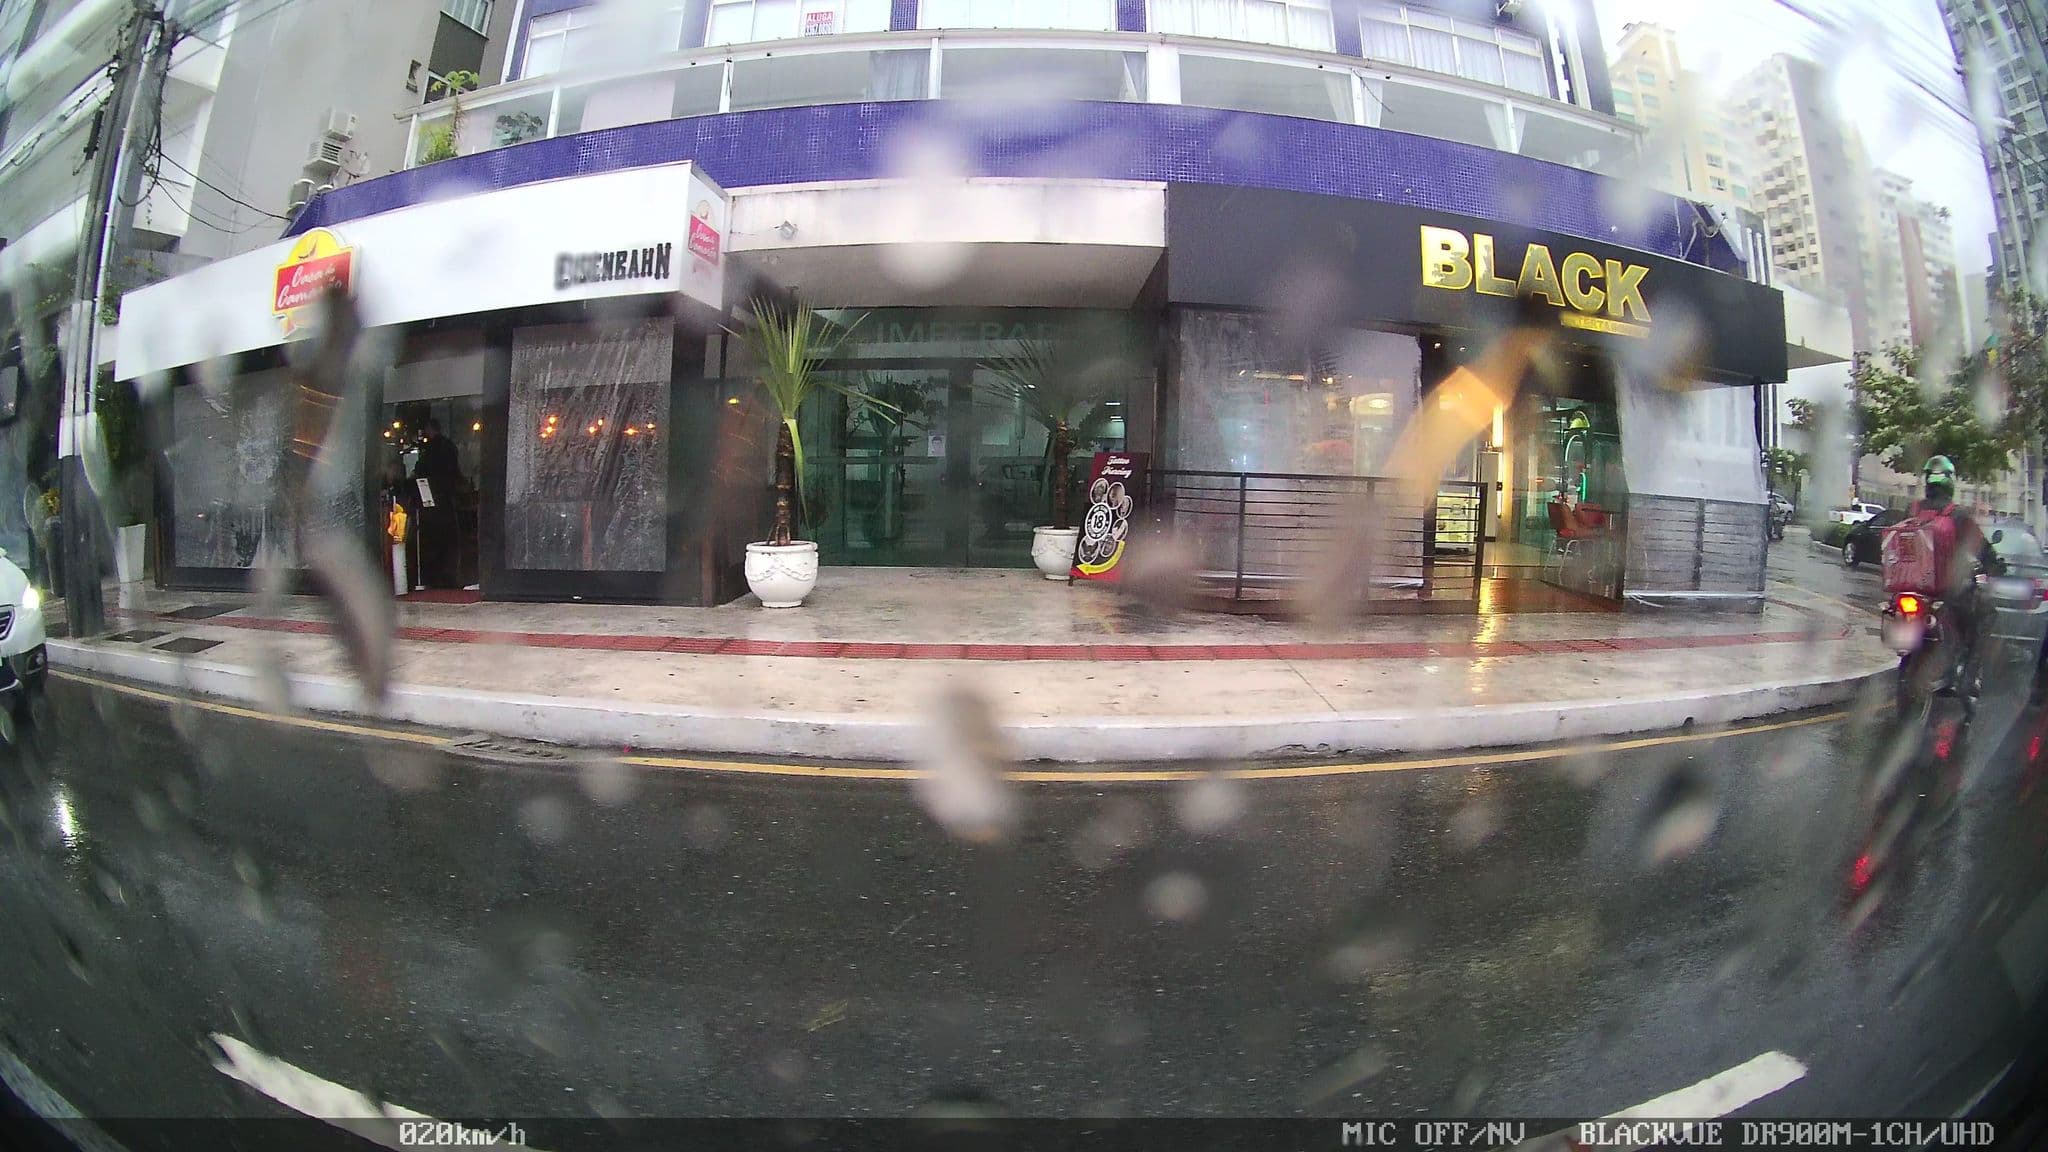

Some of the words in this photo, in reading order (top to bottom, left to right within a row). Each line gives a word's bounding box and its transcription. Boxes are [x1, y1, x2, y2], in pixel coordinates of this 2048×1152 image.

[806, 12, 833, 22] ALUGA
[554, 242, 671, 290] ENBAHN
[1420, 225, 1652, 322] BLACK
[277, 276, 343, 308] Camo
[1093, 514, 1105, 530] 18
